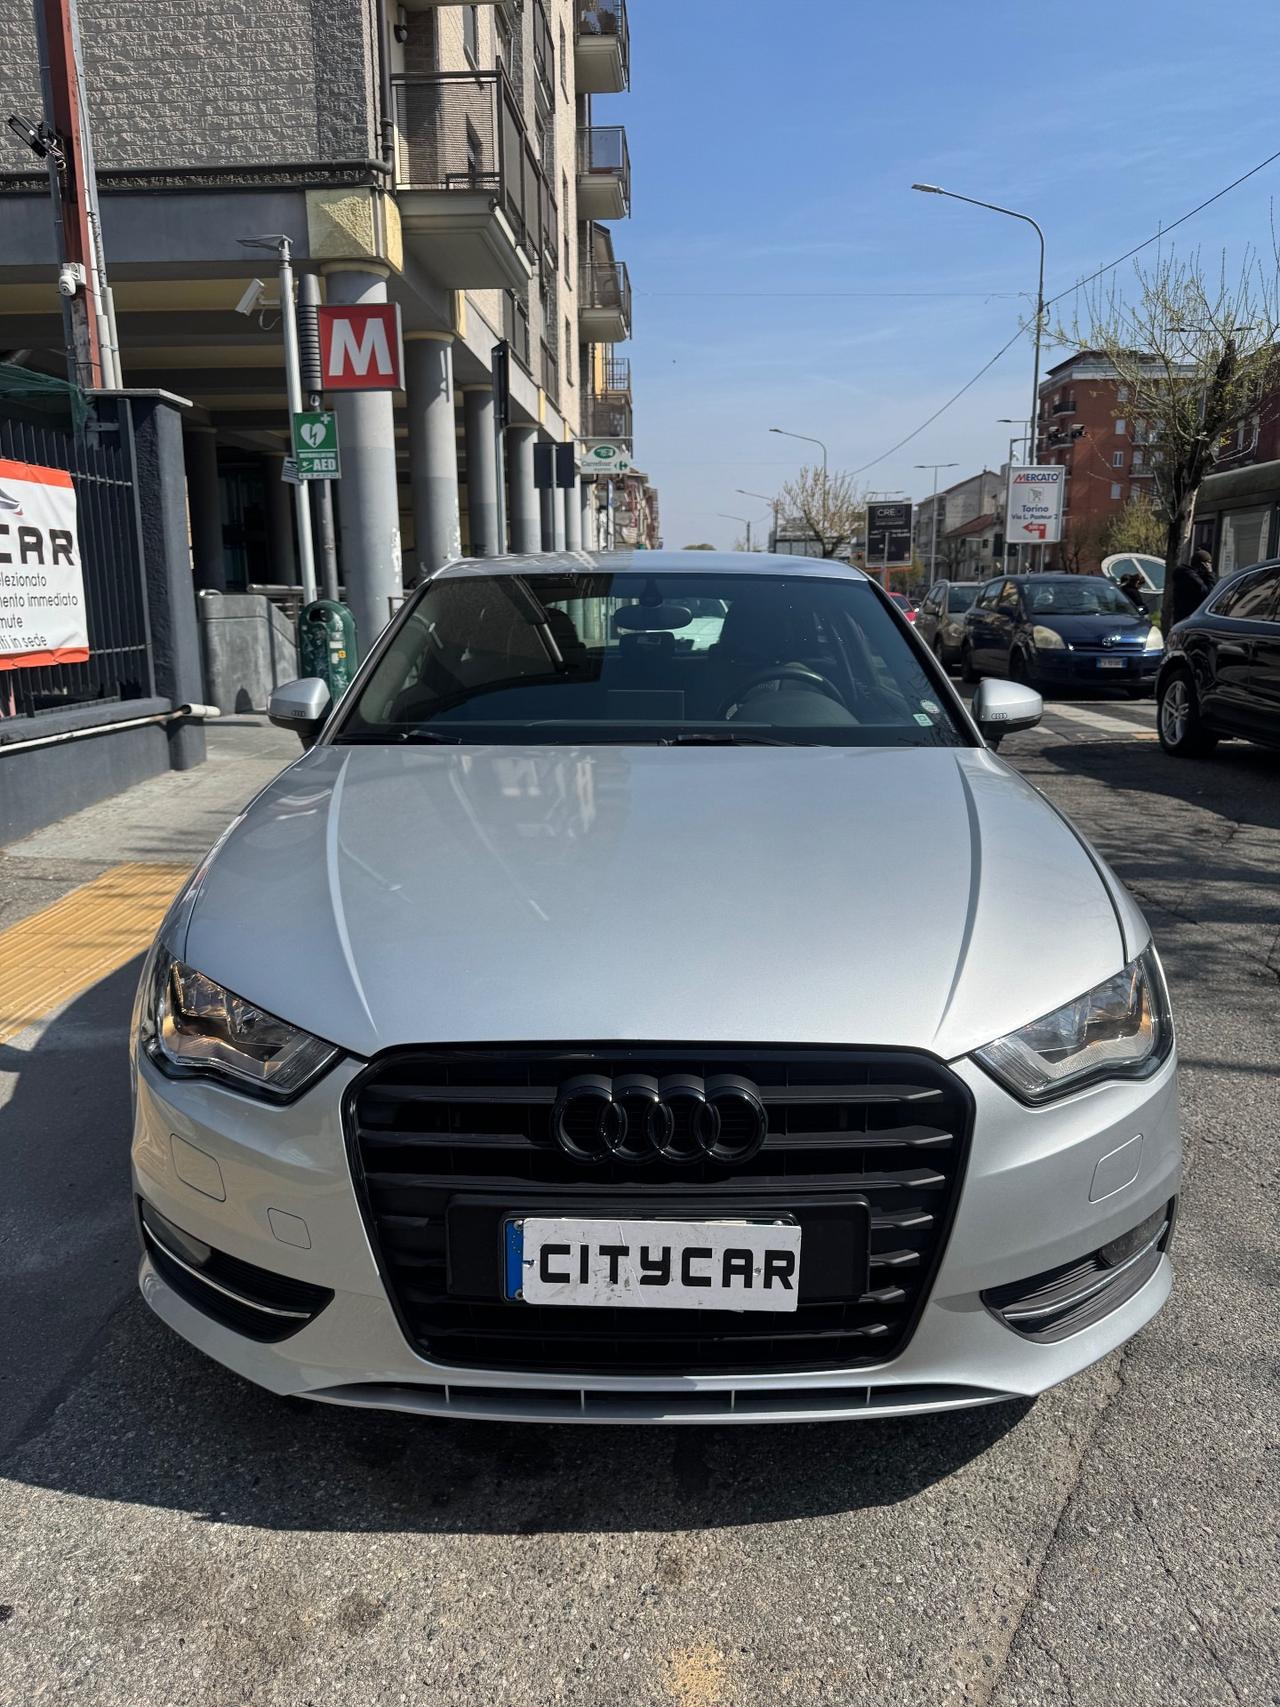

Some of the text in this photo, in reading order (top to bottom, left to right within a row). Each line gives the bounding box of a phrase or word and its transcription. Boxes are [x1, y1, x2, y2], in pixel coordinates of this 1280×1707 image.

[329, 318, 394, 377] M
[313, 459, 336, 471] AED
[1021, 504, 1049, 512] Torino
[0, 571, 47, 587] lezionato
[27, 592, 78, 607] immediato
[22, 633, 47, 647] sede
[539, 1243, 796, 1290] CITYCAR
